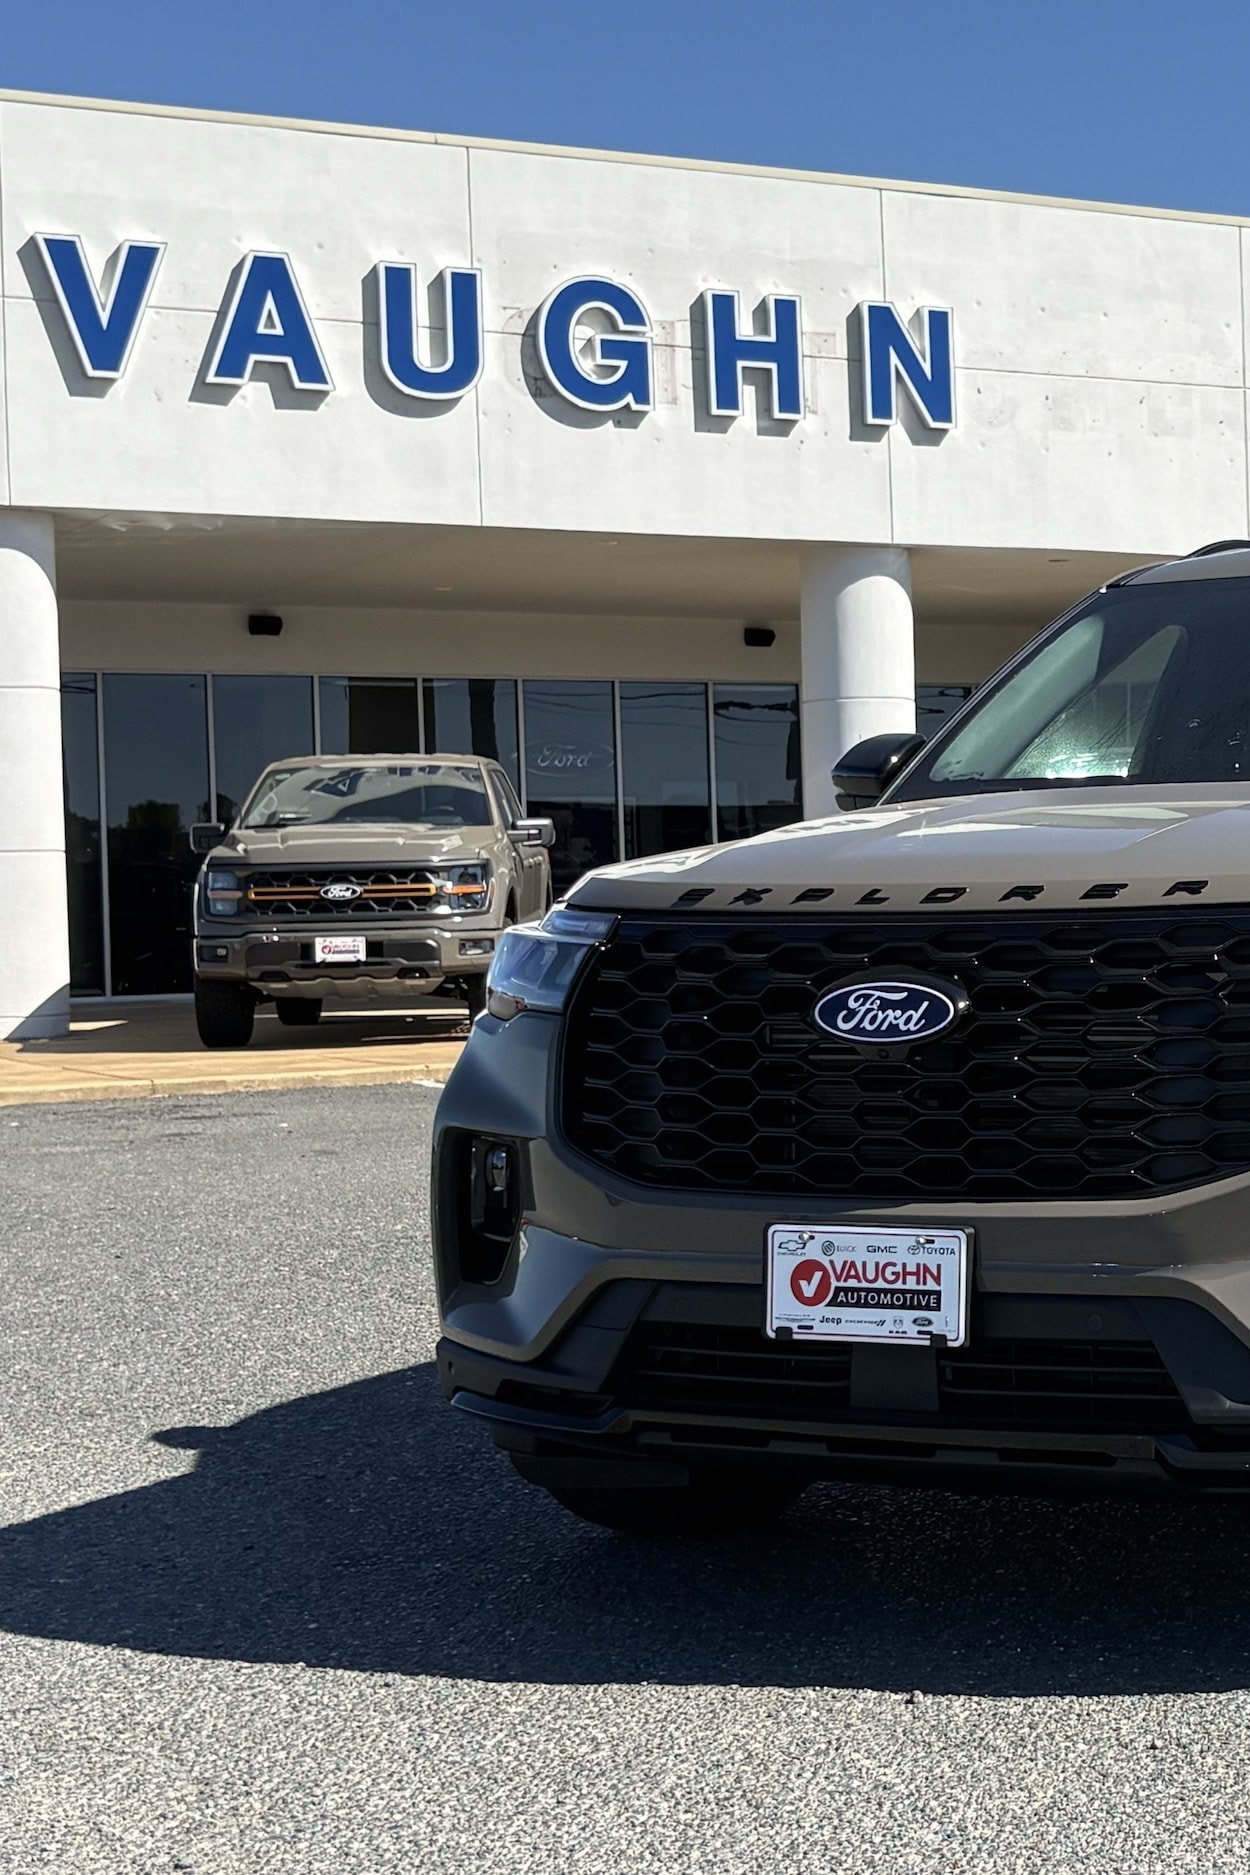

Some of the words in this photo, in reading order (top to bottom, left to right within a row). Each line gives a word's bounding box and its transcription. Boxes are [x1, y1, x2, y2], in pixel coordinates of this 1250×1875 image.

[34, 232, 957, 430] VAUGHN
[537, 743, 593, 768] Ford
[327, 886, 353, 898] Ford
[670, 880, 1209, 908] EXPLORER
[836, 989, 930, 1032] Ford
[866, 1244, 898, 1254] GMC
[922, 1246, 956, 1256] TOYOTA
[829, 1259, 942, 1287] VAUGHN
[836, 1291, 938, 1307] AUTOMOTIVE
[819, 1315, 842, 1326] Jeep
